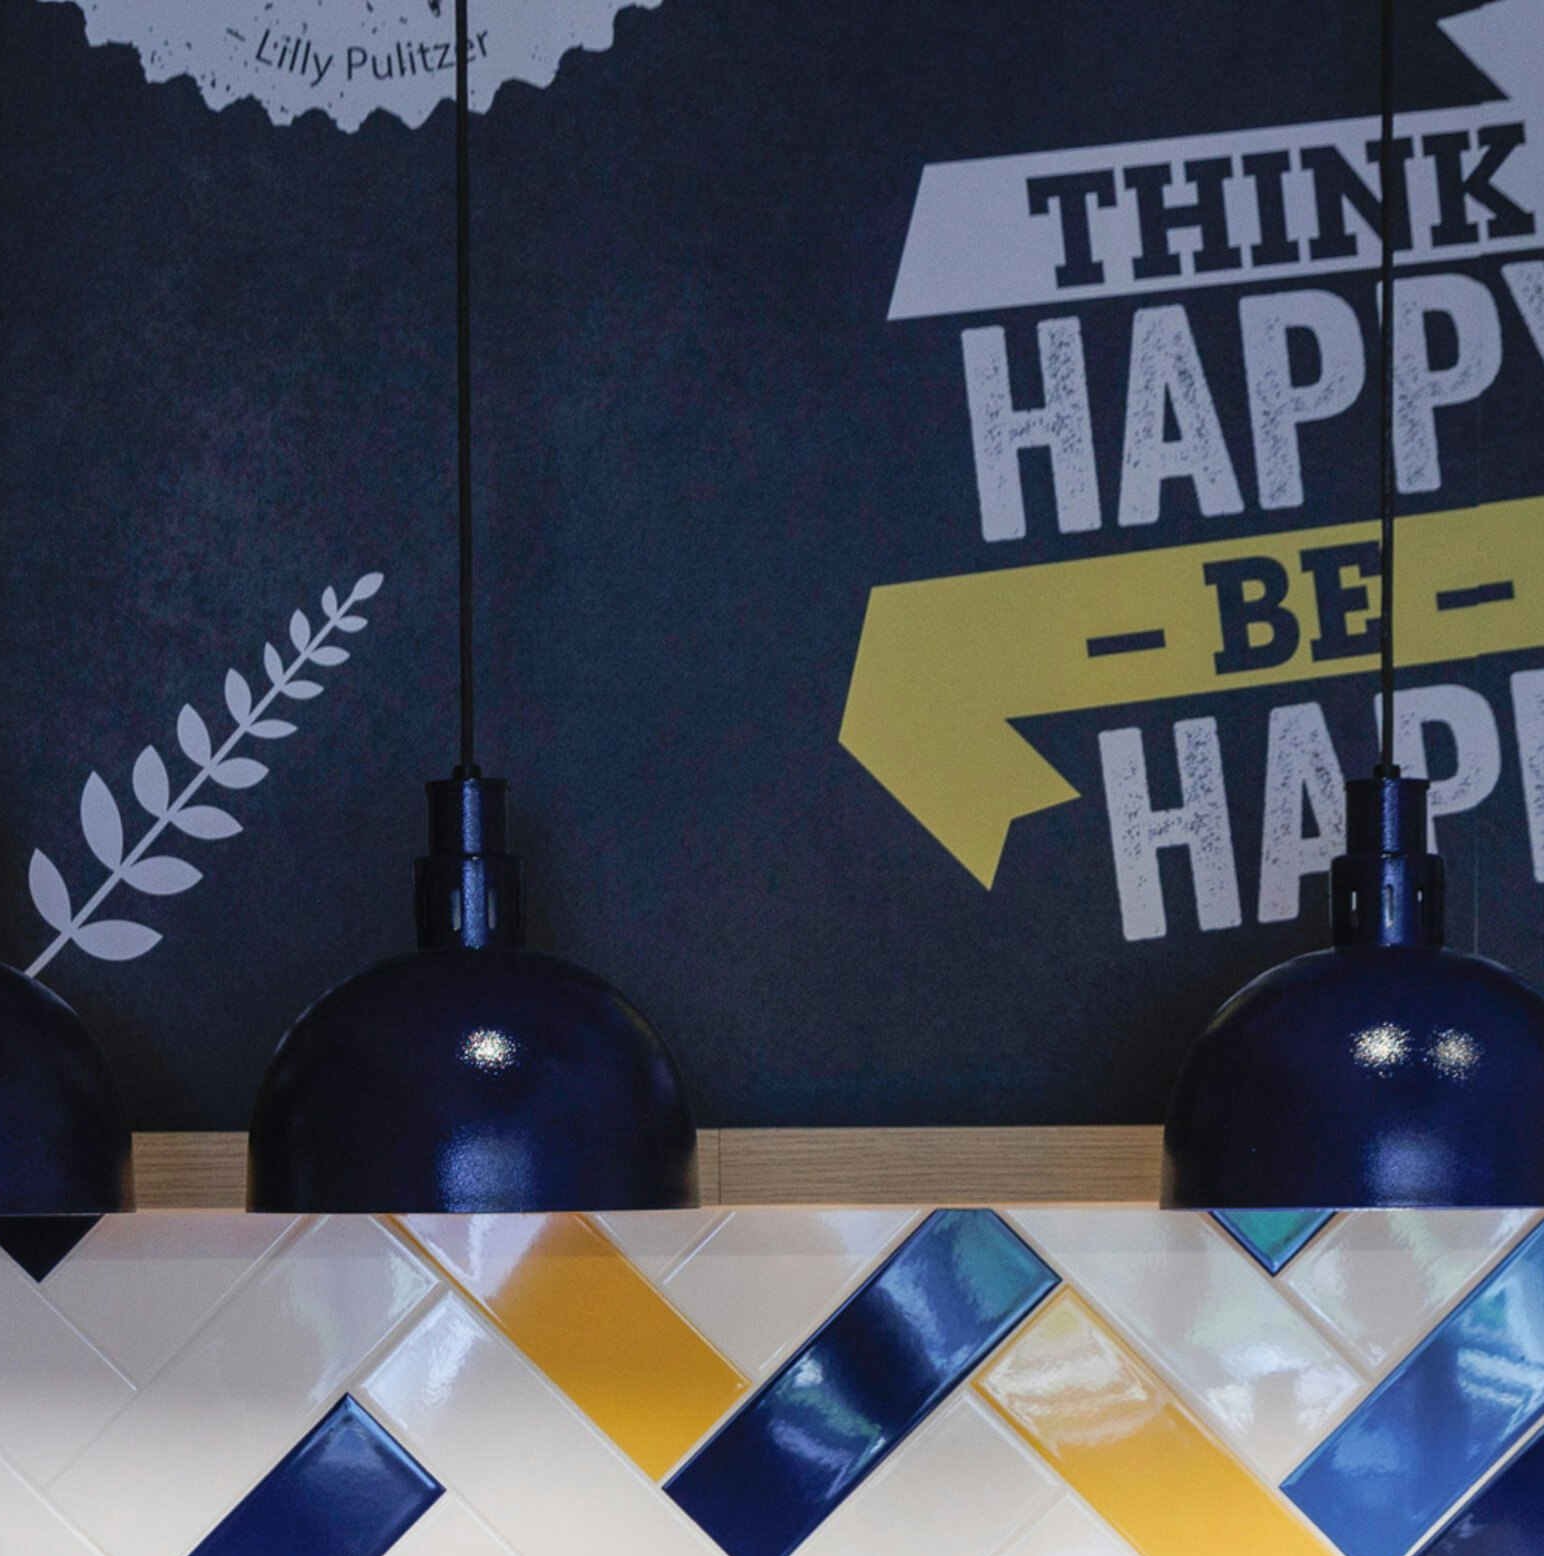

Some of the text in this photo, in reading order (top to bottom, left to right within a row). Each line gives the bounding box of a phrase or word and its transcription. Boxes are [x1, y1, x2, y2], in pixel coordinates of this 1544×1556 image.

[255, 28, 333, 88] Lilly
[1026, 120, 1536, 288] THINK
[1202, 541, 1386, 676] BE
